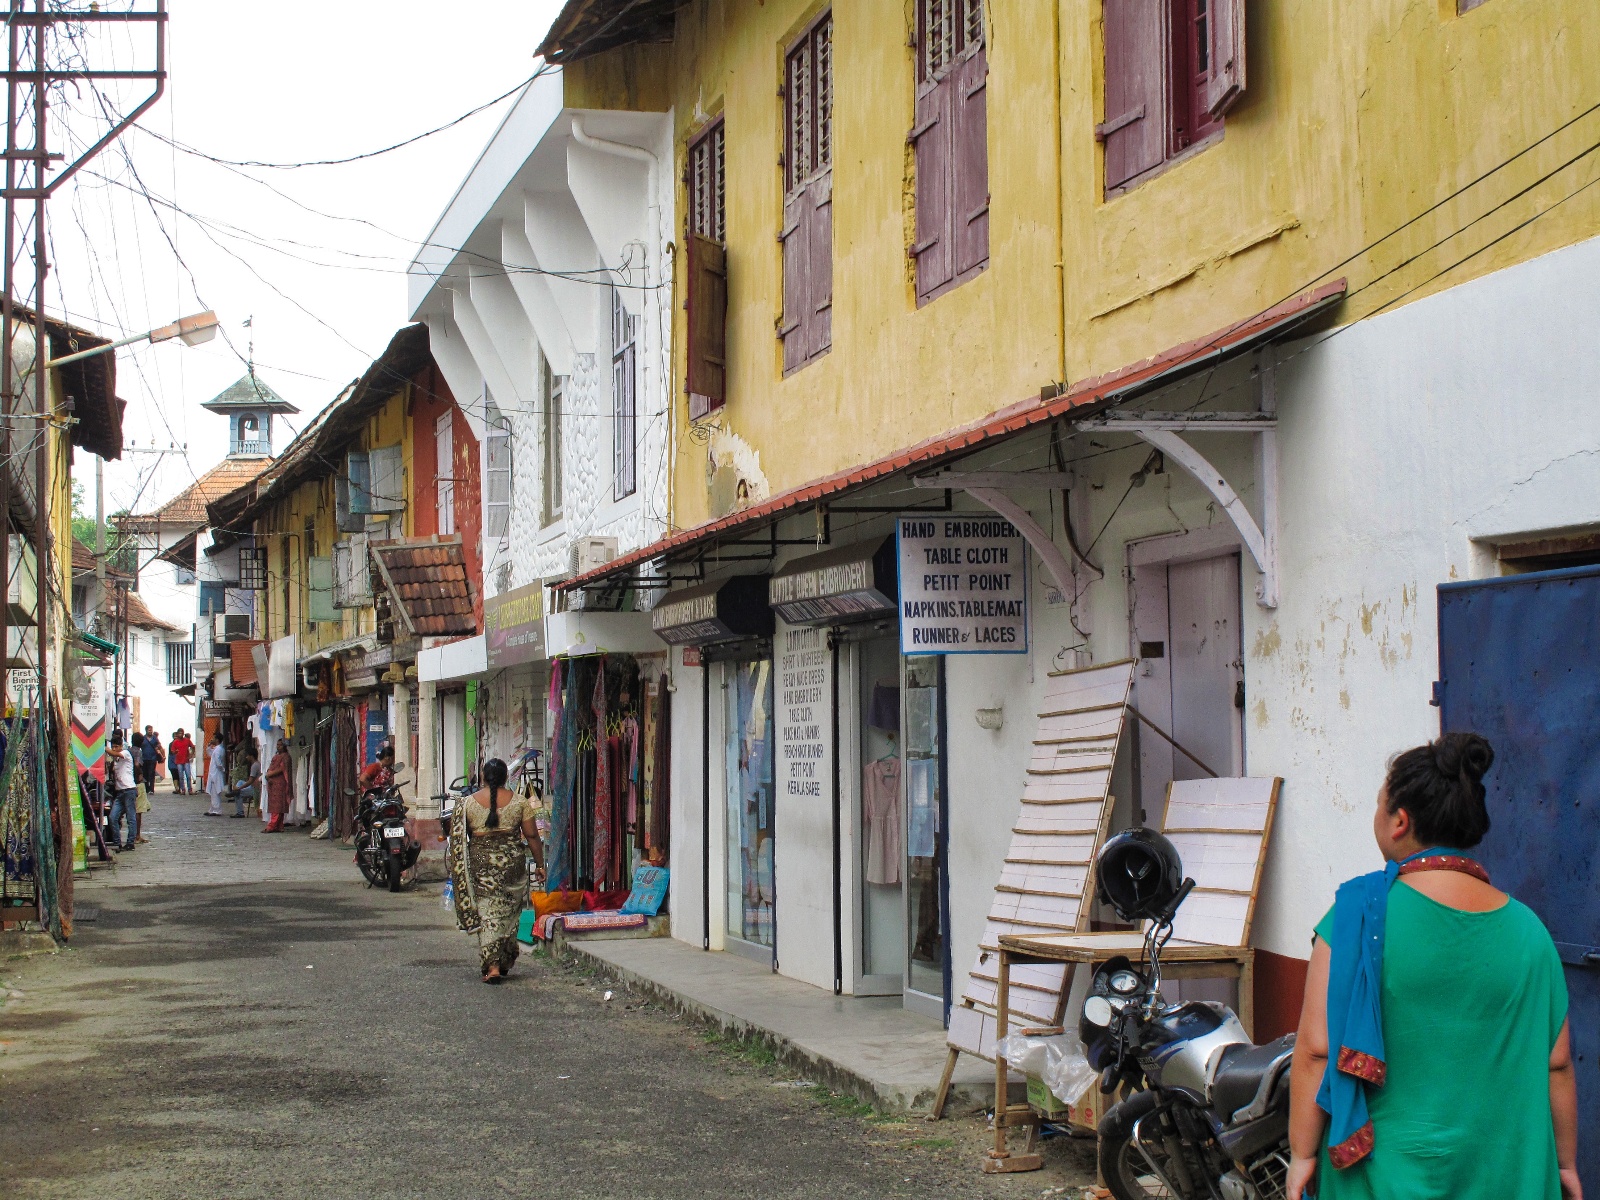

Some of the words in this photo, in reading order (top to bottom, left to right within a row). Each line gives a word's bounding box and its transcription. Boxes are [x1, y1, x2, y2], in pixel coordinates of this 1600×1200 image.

[902, 522, 935, 538] HAND
[924, 548, 961, 564] TABLE
[967, 548, 1008, 564] CLOTH
[771, 573, 793, 604] LITTLE
[796, 569, 817, 599] QUEEN
[819, 561, 866, 595] EMBROIDERY
[924, 575, 959, 591] PETIT
[970, 574, 1011, 591] POINT
[912, 627, 959, 644] RUNNER
[975, 627, 1016, 643] LACES
